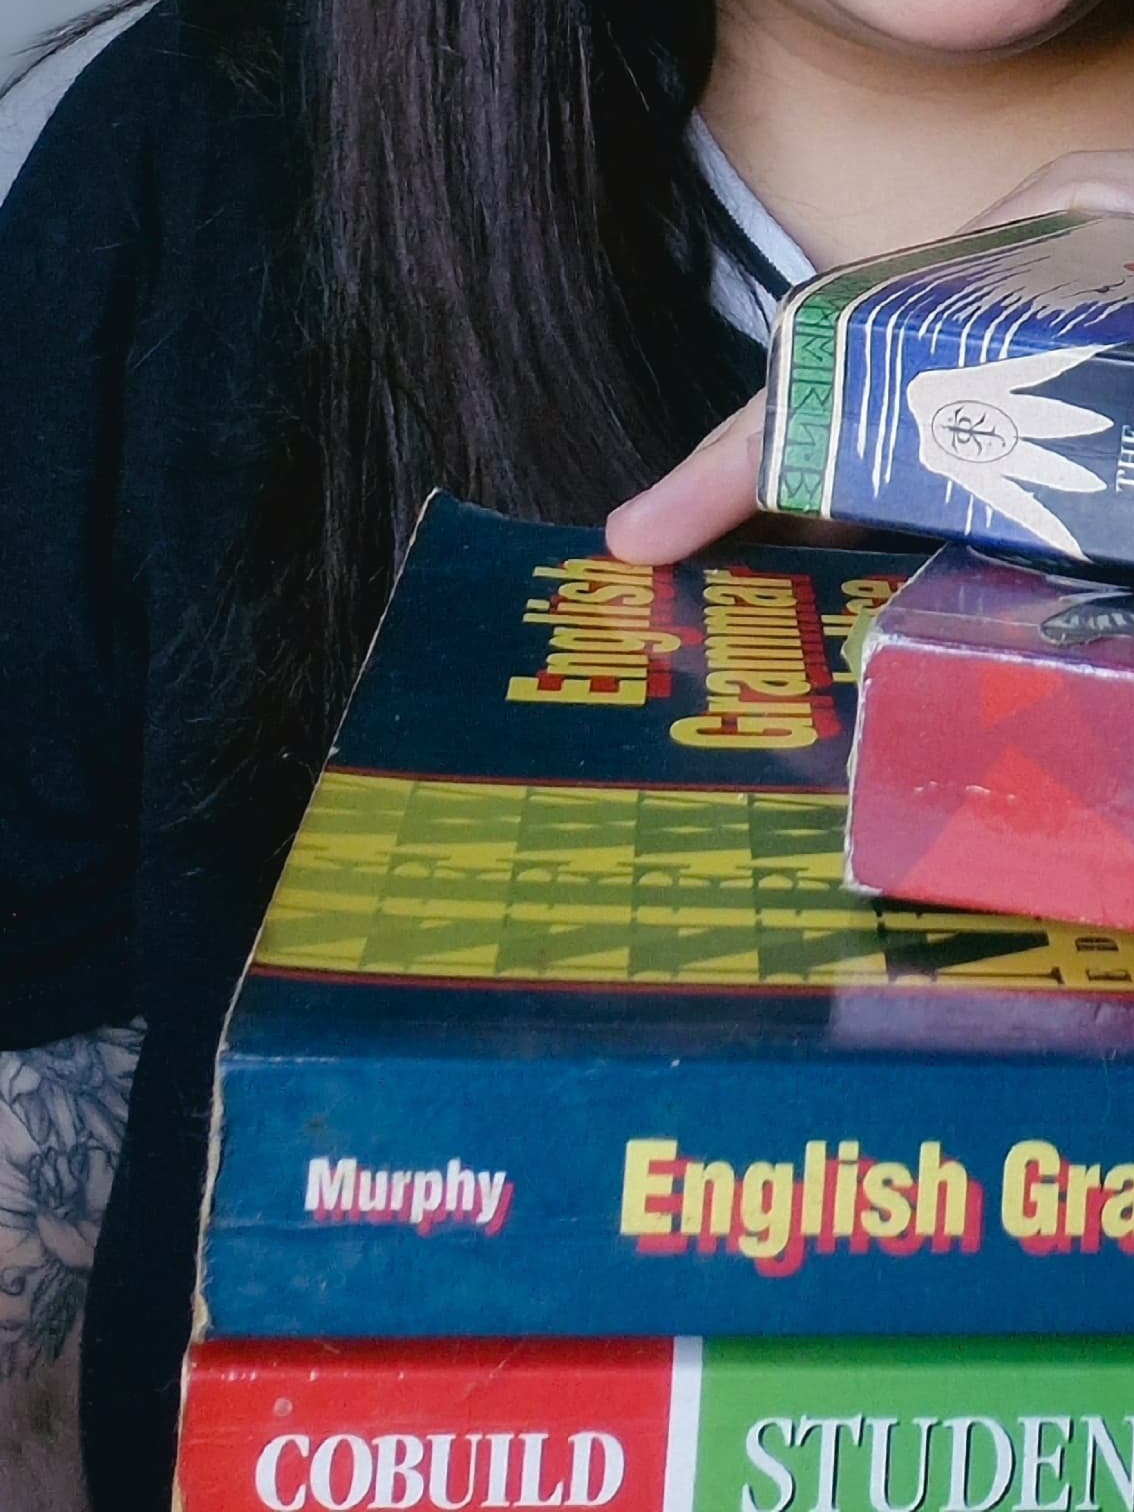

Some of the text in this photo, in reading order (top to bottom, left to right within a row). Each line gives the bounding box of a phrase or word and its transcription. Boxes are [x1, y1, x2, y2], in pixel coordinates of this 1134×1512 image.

[505, 558, 681, 706] English
[669, 568, 818, 749] Grammar
[304, 1157, 508, 1228] Murphy
[621, 1138, 971, 1262] English
[254, 1430, 625, 1511] COBUILD
